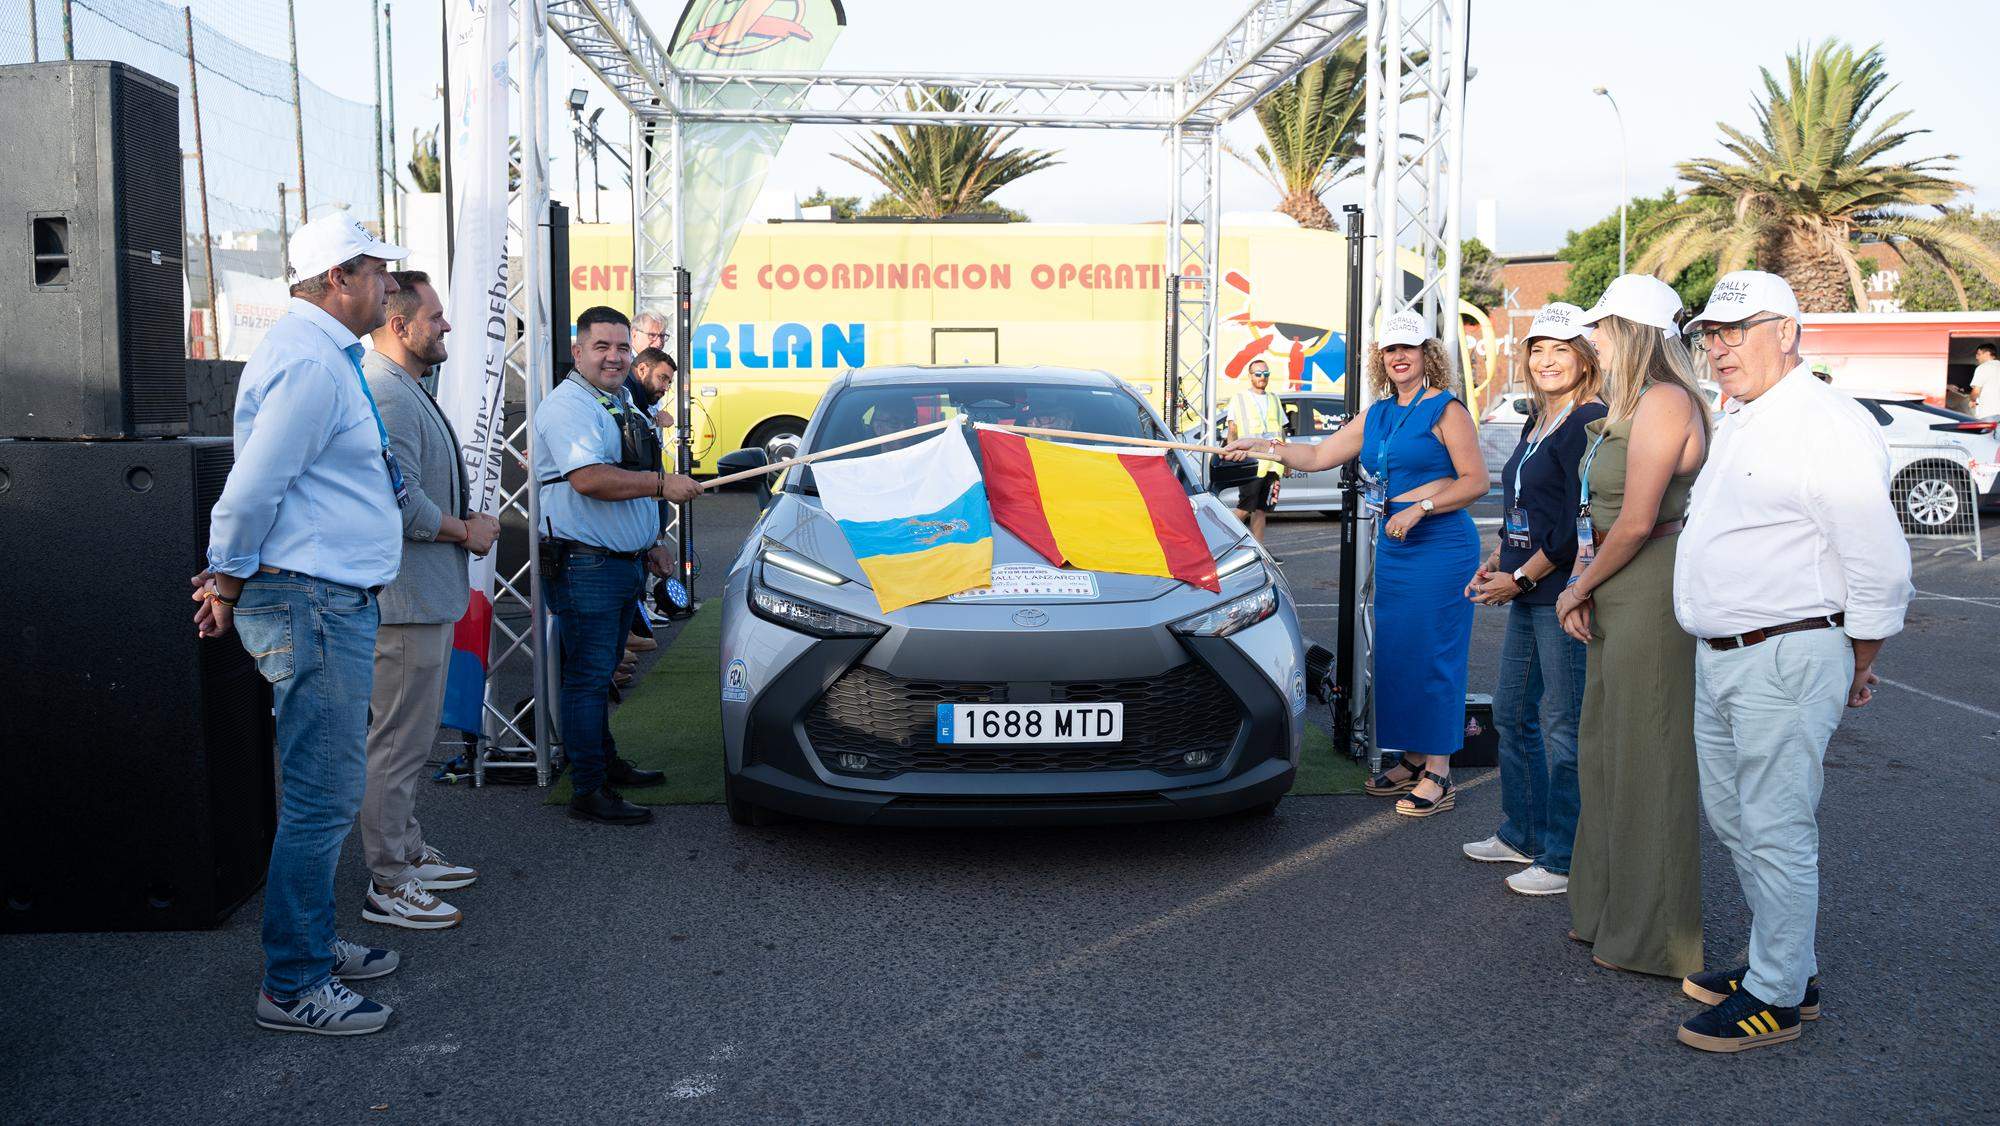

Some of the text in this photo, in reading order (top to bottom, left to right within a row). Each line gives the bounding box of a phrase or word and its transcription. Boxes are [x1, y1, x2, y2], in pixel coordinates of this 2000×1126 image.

[571, 263, 1203, 291] ENT E COORDINACION OPERATIA
[1719, 281, 1750, 292] RALLY
[1546, 308, 1571, 317] RALLY
[692, 322, 865, 369] RLAN
[942, 728, 949, 736] E
[966, 709, 1114, 738] 1688 MTD
[293, 1000, 328, 1027] N
